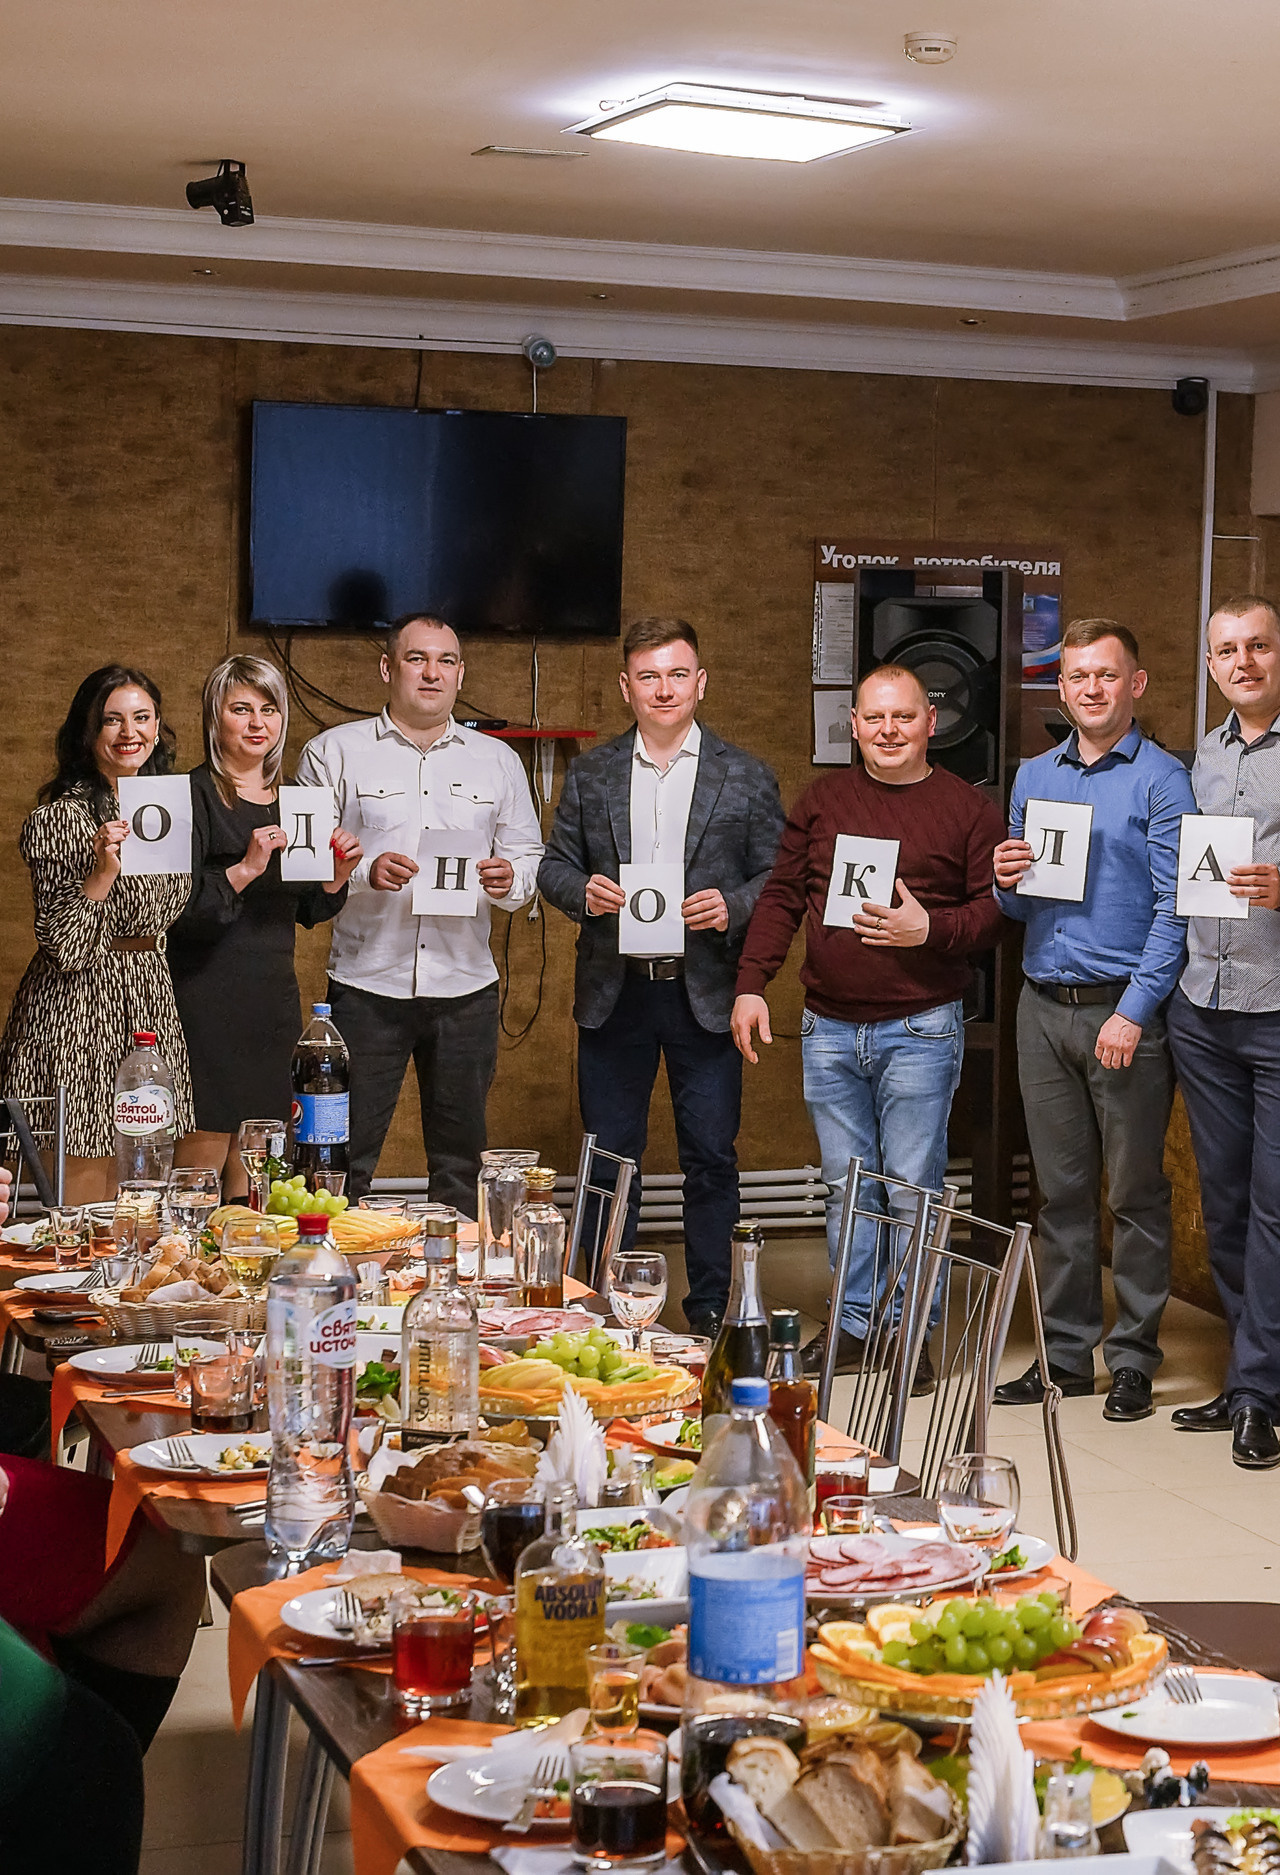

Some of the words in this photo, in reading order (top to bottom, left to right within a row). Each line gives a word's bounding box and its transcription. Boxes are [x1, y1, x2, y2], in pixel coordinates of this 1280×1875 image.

[821, 545, 899, 568] Уголок
[132, 803, 172, 843] О
[287, 813, 316, 859] Д
[1031, 827, 1068, 866] Л
[1188, 843, 1227, 882] А
[430, 855, 472, 891] Н
[837, 861, 877, 899] К
[629, 888, 666, 923] О
[534, 1579, 603, 1602] ABSOLUT
[542, 1600, 598, 1620] VODKA
